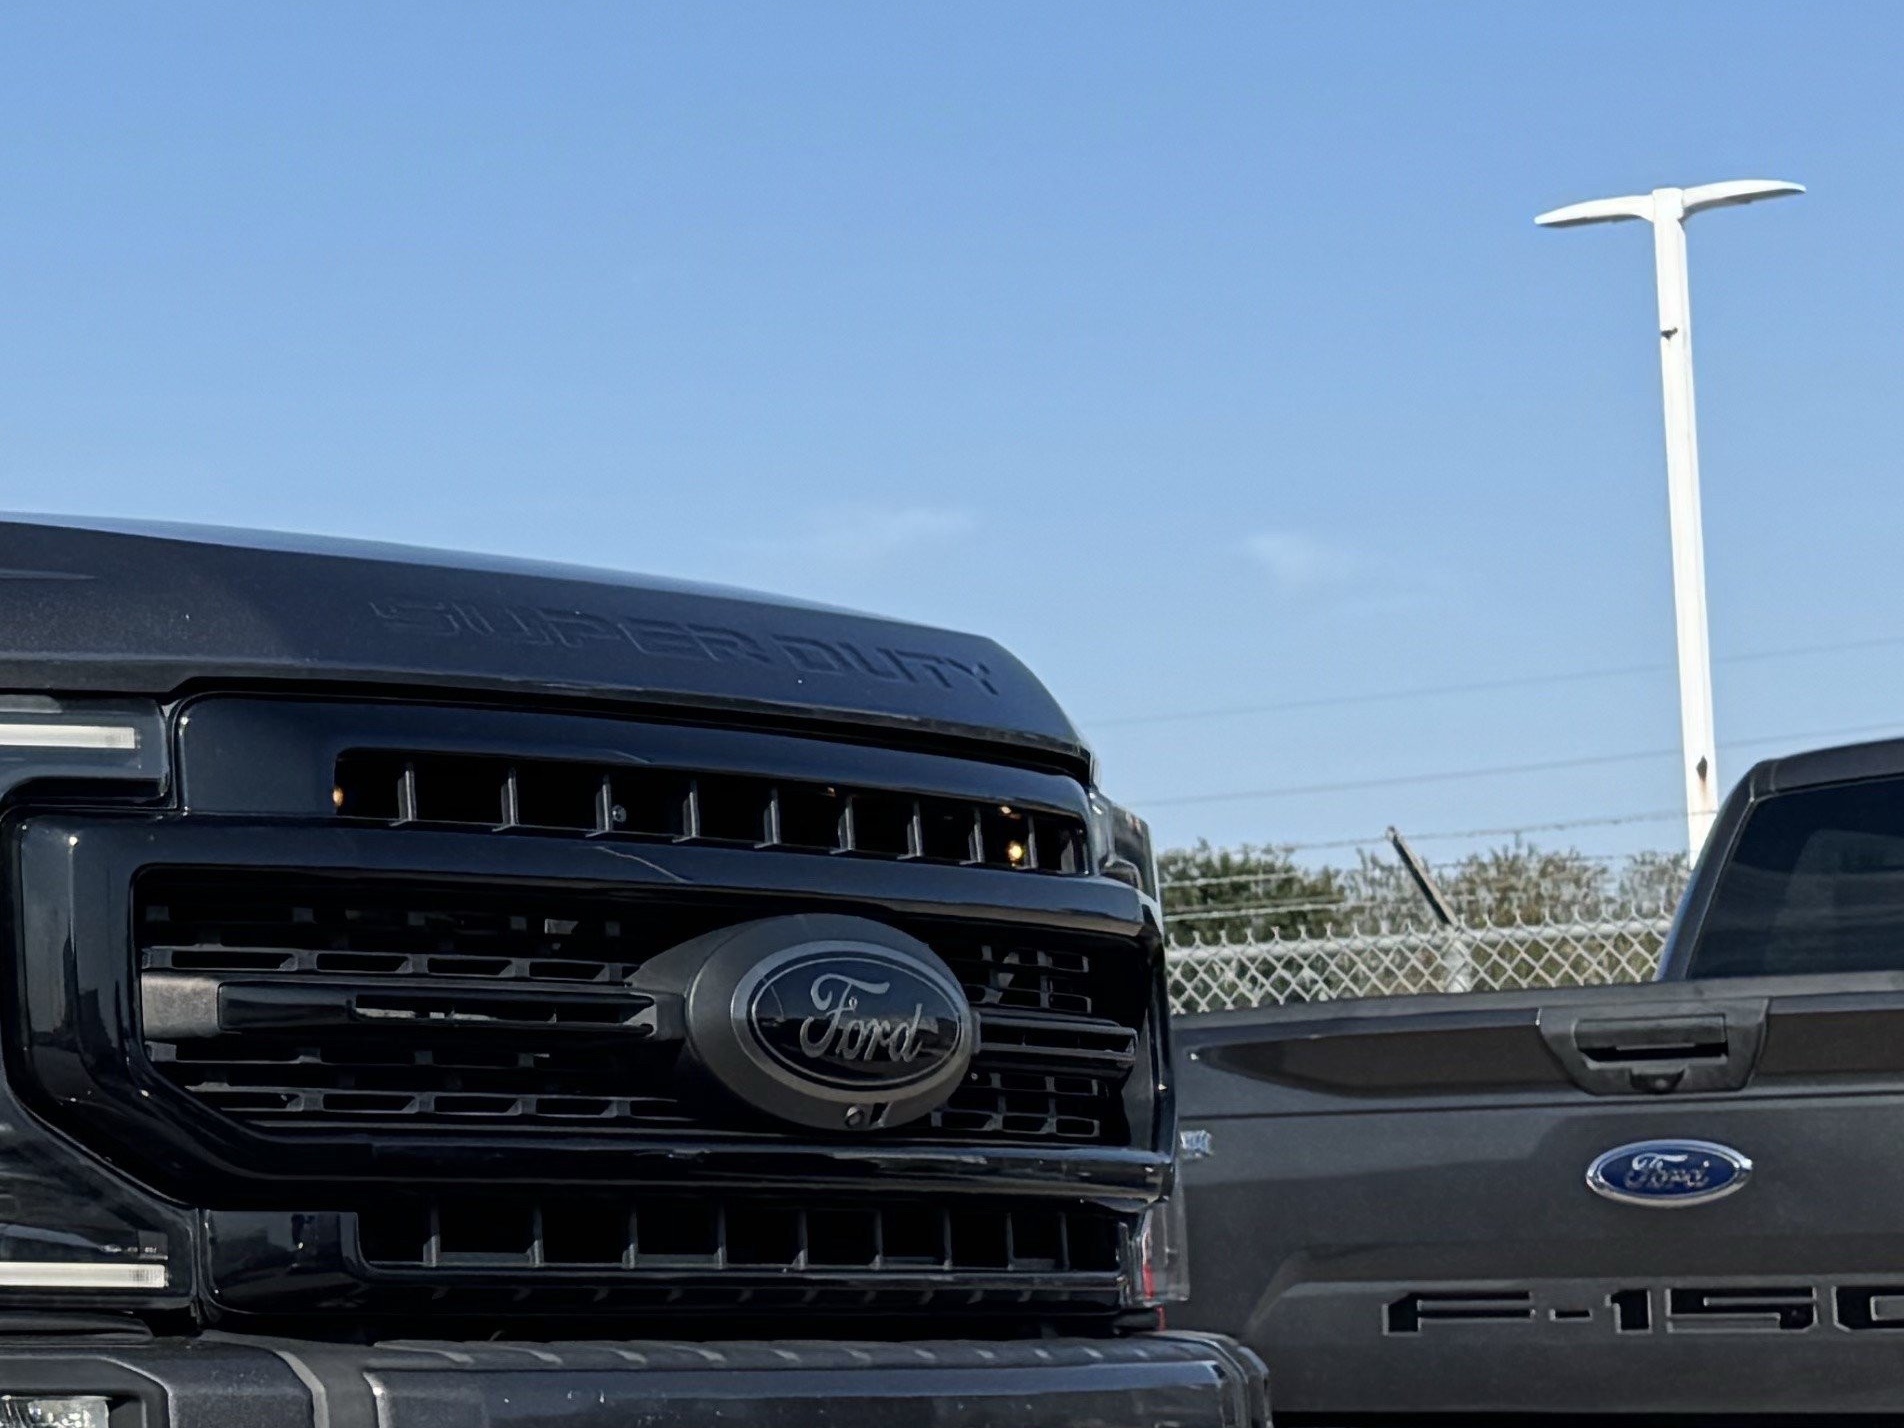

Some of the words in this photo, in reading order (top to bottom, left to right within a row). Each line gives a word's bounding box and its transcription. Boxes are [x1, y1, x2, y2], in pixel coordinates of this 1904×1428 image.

[369, 602, 769, 662] SUPER
[769, 634, 999, 696] DUTY
[799, 973, 922, 1062] Ford
[1624, 1152, 1710, 1189] Ford
